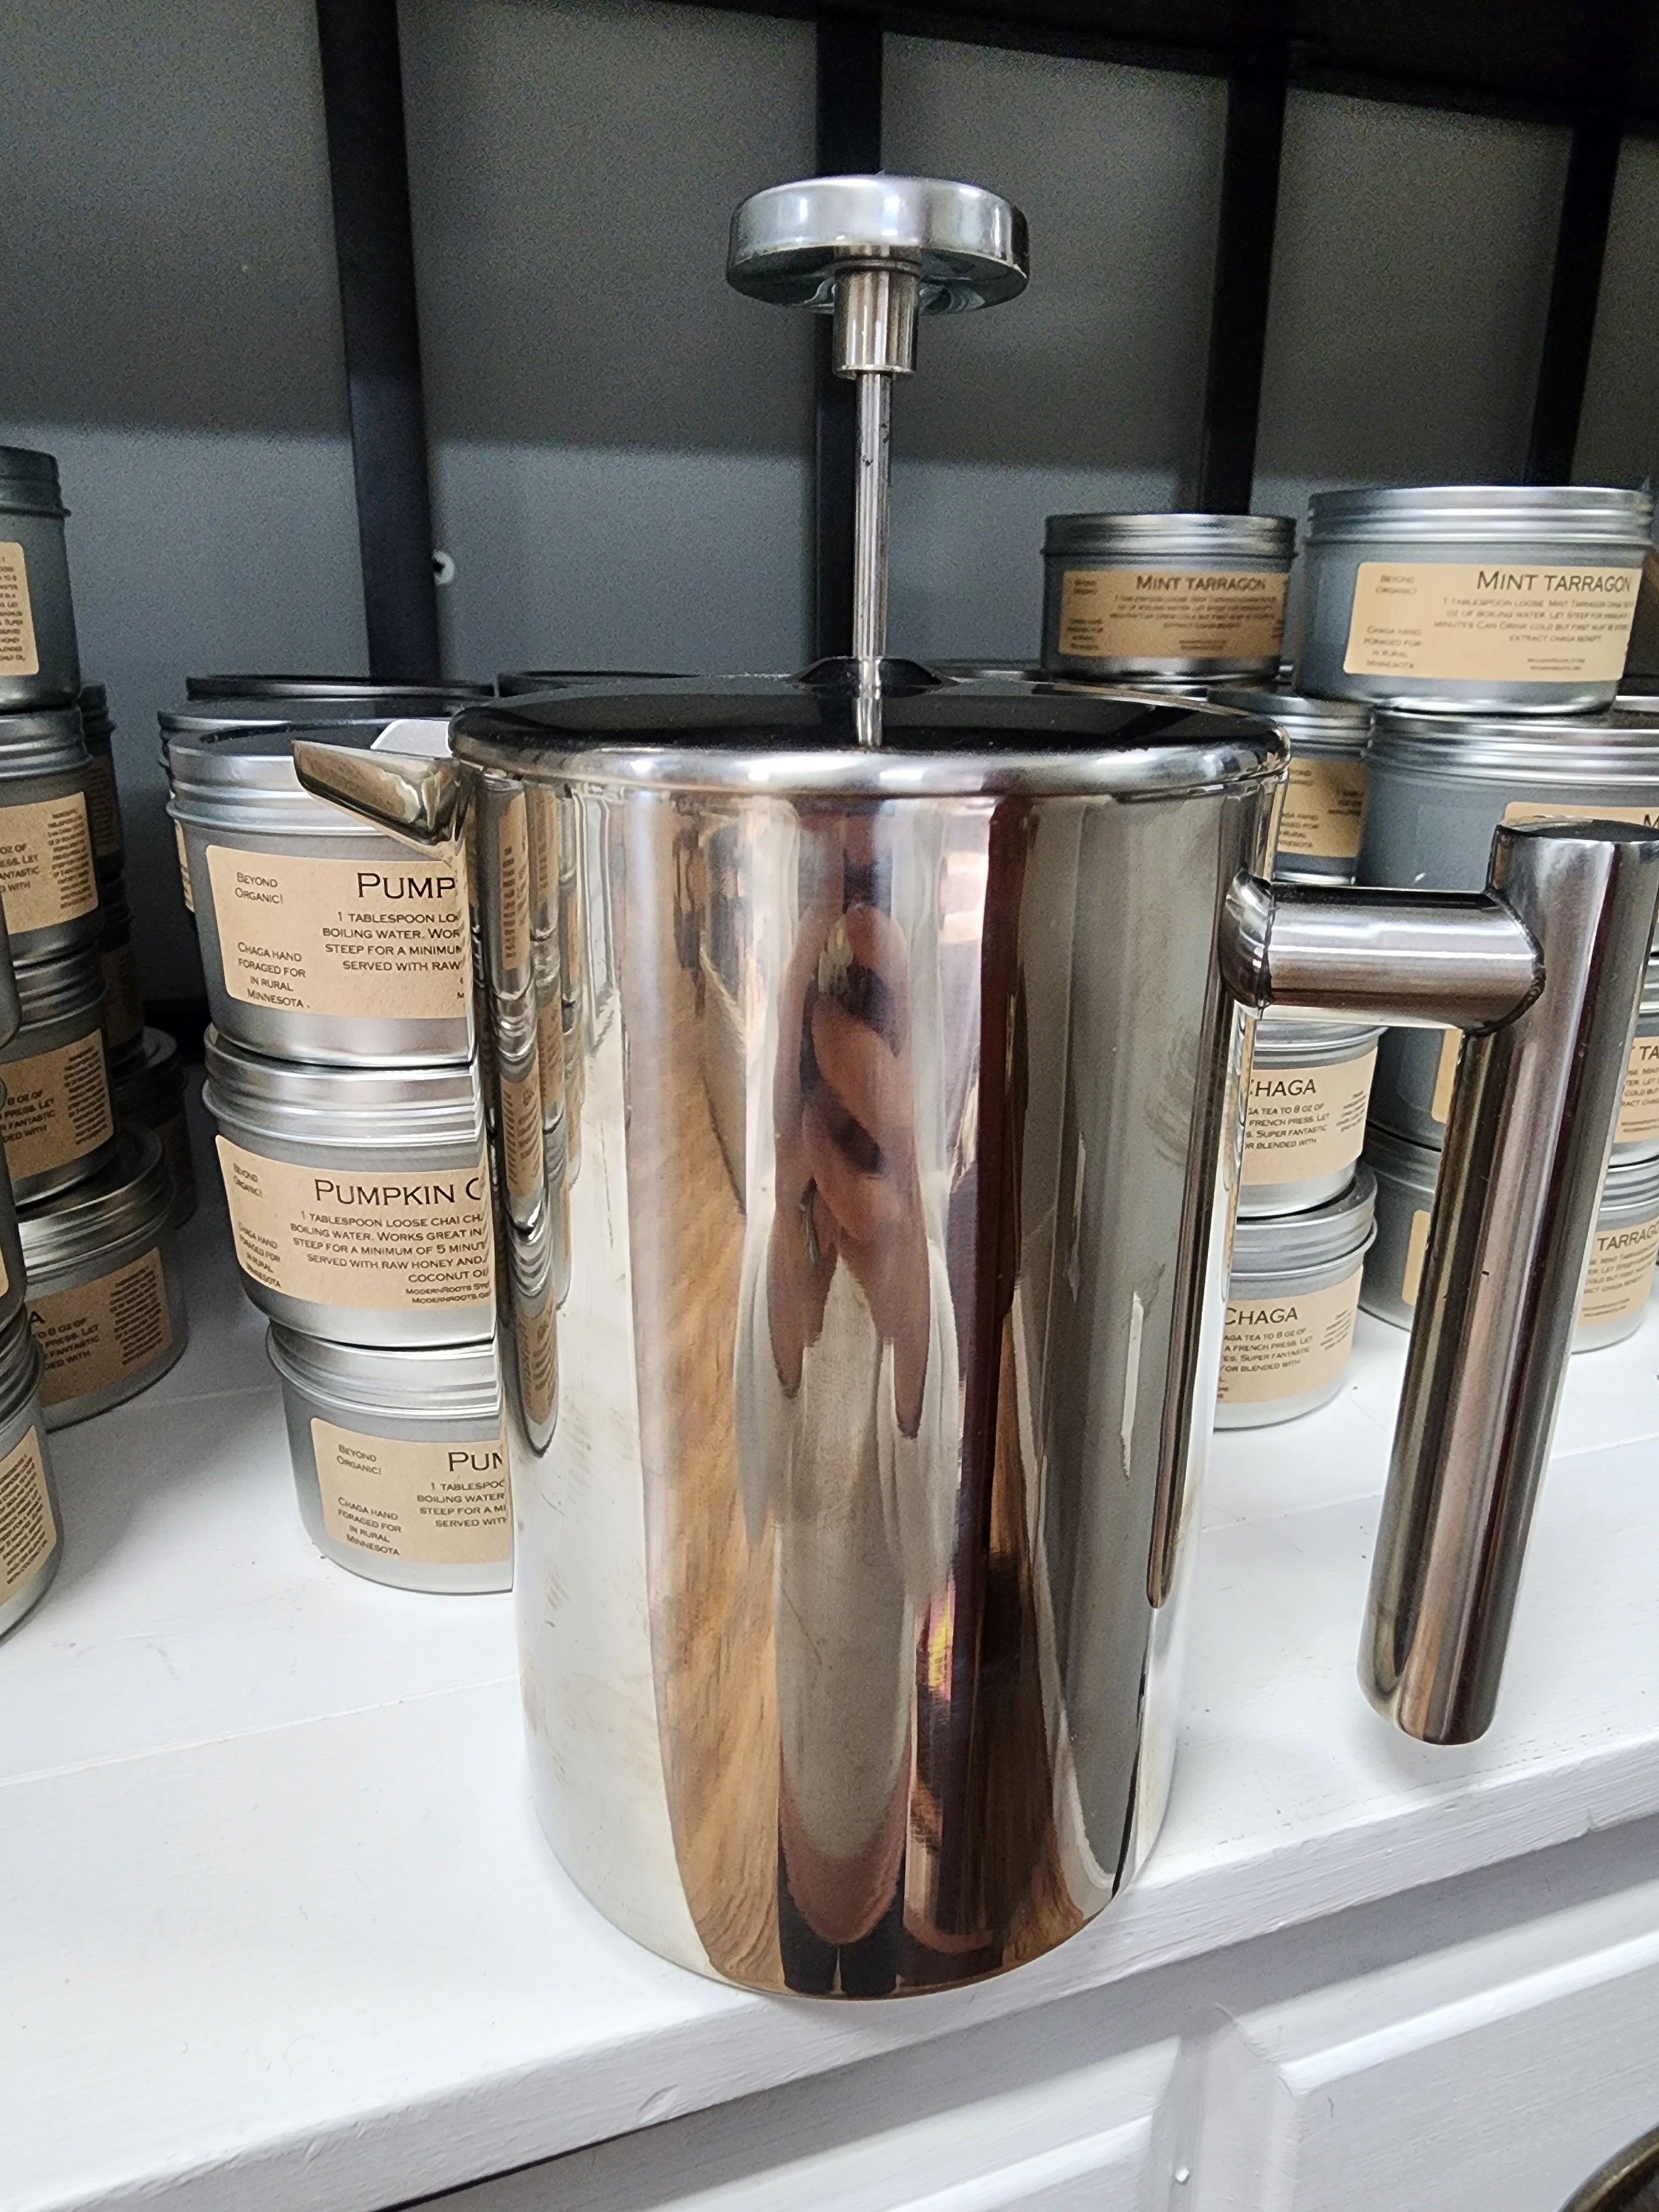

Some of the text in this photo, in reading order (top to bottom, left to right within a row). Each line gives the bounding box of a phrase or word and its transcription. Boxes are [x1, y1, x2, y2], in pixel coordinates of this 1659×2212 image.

[1136, 575, 1265, 591] MINT TARRAGON
[1477, 571, 1631, 592] MINT TARRAGON
[22, 853, 39, 864] LET
[0, 865, 40, 881] ANTASTIC
[237, 872, 278, 888] BEYOND
[8, 880, 32, 893] WITH
[357, 872, 456, 899] PUMP
[235, 887, 284, 904] ORGANIC!
[337, 911, 435, 924] 1 TABLESPOON
[322, 927, 373, 939] BOILING
[238, 941, 302, 962] CHAGA HAND
[325, 943, 364, 954] STEEP
[368, 946, 394, 956] FOR
[397, 947, 406, 956] A
[238, 957, 306, 978] FORAGED FOR
[342, 960, 461, 972] SERVED WITH RAW
[250, 975, 294, 992] IN RURAL
[247, 988, 305, 1009] MINNESOTA
[1262, 1107, 1278, 1115] TEA
[1280, 1107, 1292, 1115] TO
[1302, 1103, 1313, 1113] OZ
[1249, 1118, 1287, 1127] FRENCH
[1256, 1129, 1287, 1139] SUPER
[1256, 1140, 1297, 1150] BLENDED
[314, 1178, 456, 1206] PUMPKIN
[309, 1212, 383, 1228] TABLESPOON
[386, 1218, 429, 1228] LOOSE
[431, 1215, 460, 1227] CHAI
[290, 1223, 330, 1238] BOILING
[377, 1232, 424, 1241] WORKS
[426, 1229, 467, 1241] GREAT
[469, 1228, 482, 1238] IN
[293, 1237, 324, 1250] STEEP
[326, 1243, 349, 1254] FOR
[351, 1245, 359, 1255] A
[361, 1246, 413, 1256] MINIMUM
[415, 1245, 434, 1255] OF
[436, 1244, 446, 1254] 5
[307, 1254, 483, 1270] SERVED WITH RAW HONEY AND
[408, 1270, 471, 1283] COCONUT
[405, 1285, 472, 1295] MODERNROOTS
[1224, 1307, 1298, 1326] CHAGA
[1284, 1329, 1295, 1338] OZ
[1233, 1344, 1270, 1352] FRENCH
[1240, 1354, 1270, 1362] SUPER
[1240, 1363, 1281, 1373] BLENDED
[338, 1443, 377, 1462] BEYOND
[431, 1482, 436, 1491] 1
[417, 1495, 463, 1503] BOILING
[338, 1496, 399, 1521] CHAGA HAND
[420, 1507, 455, 1516] STEEP
[338, 1509, 403, 1533] FORAGED FOR
[435, 1519, 480, 1528] SERVED
[359, 1528, 391, 1543] RURAL
